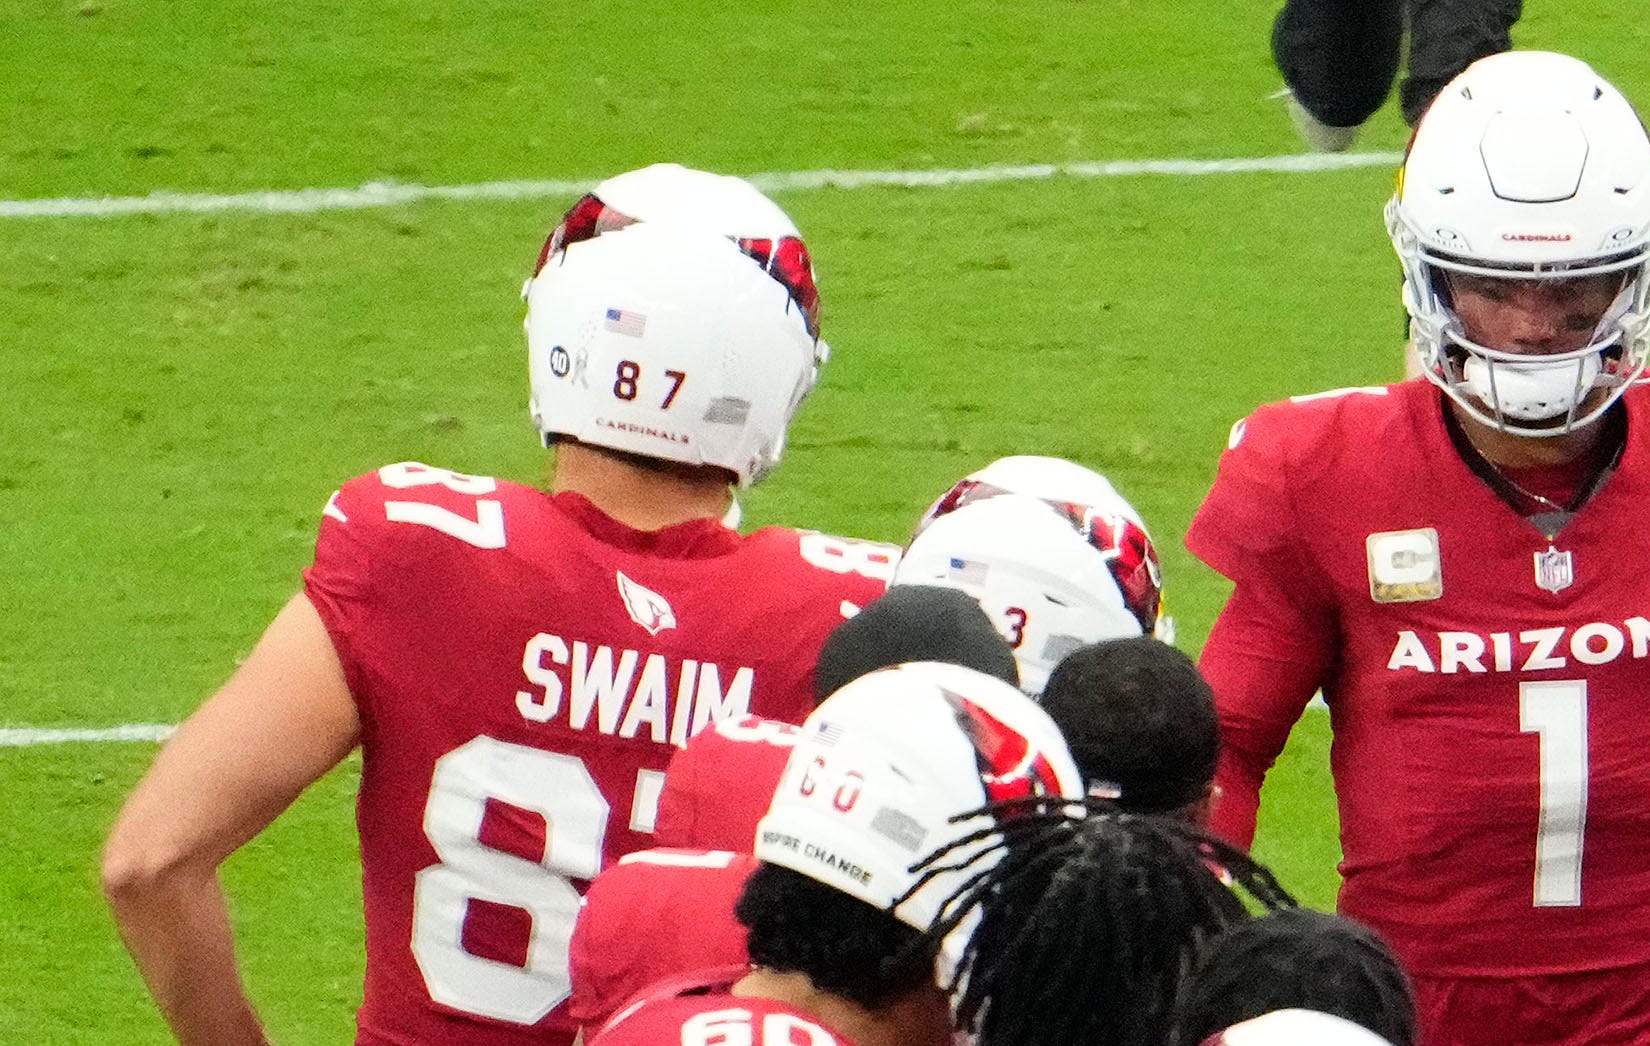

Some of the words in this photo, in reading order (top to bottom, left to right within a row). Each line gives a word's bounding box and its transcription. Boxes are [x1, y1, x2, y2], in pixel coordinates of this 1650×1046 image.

[612, 360, 687, 410] 87
[595, 417, 690, 445] CARDINALS
[1372, 534, 1435, 585] C
[515, 632, 755, 748] SWAIM
[1518, 679, 1590, 908] 1
